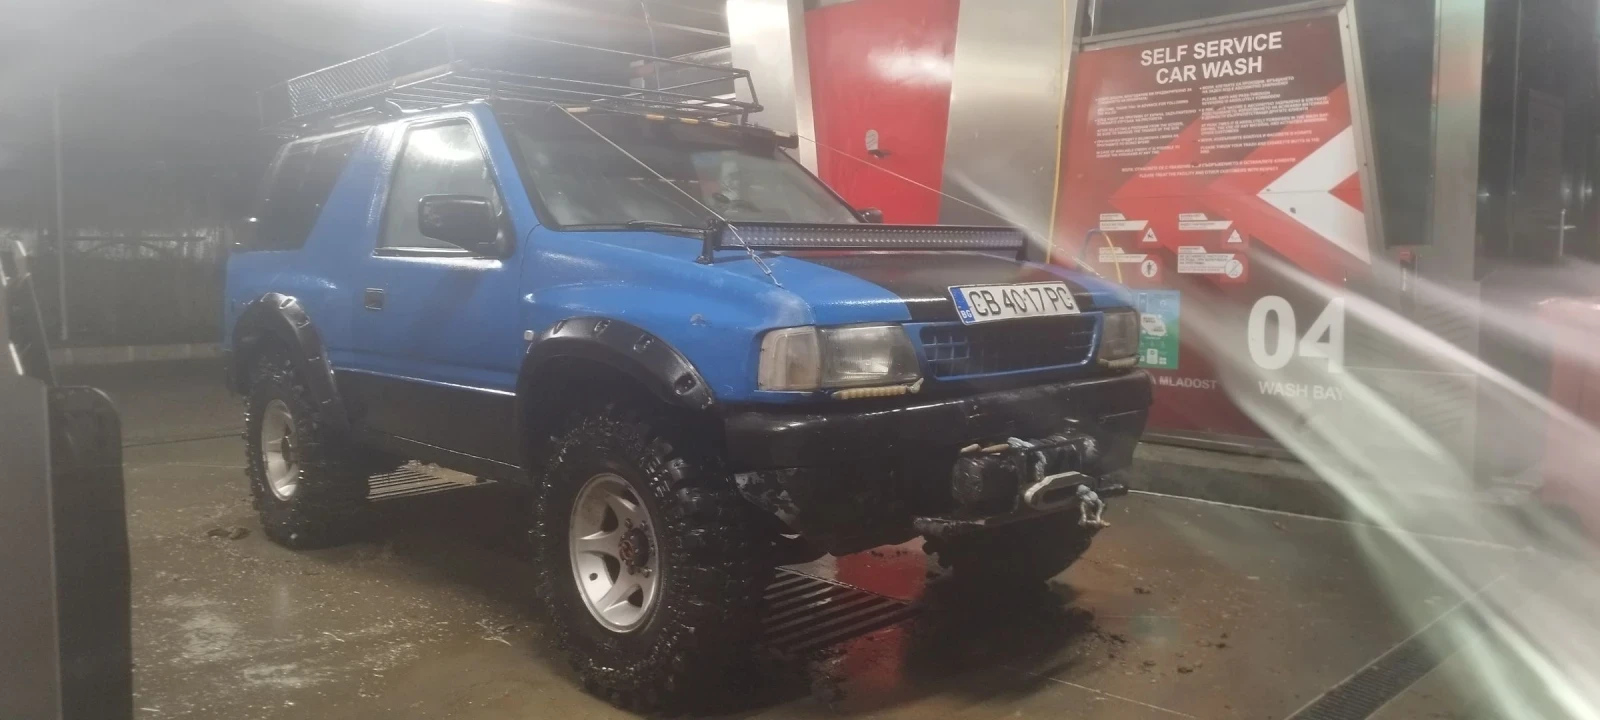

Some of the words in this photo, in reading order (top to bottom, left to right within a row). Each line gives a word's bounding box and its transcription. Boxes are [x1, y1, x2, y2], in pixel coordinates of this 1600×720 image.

[1140, 44, 1188, 67] SELF
[1193, 31, 1283, 60] SERVICE
[1155, 63, 1197, 85] CAR
[1202, 55, 1263, 79] WASH
[960, 309, 972, 319] BG
[1002, 288, 1045, 314] 4017
[1247, 295, 1345, 373] 04
[1159, 376, 1217, 389] MLADOST
[1258, 380, 1309, 398] WASH
